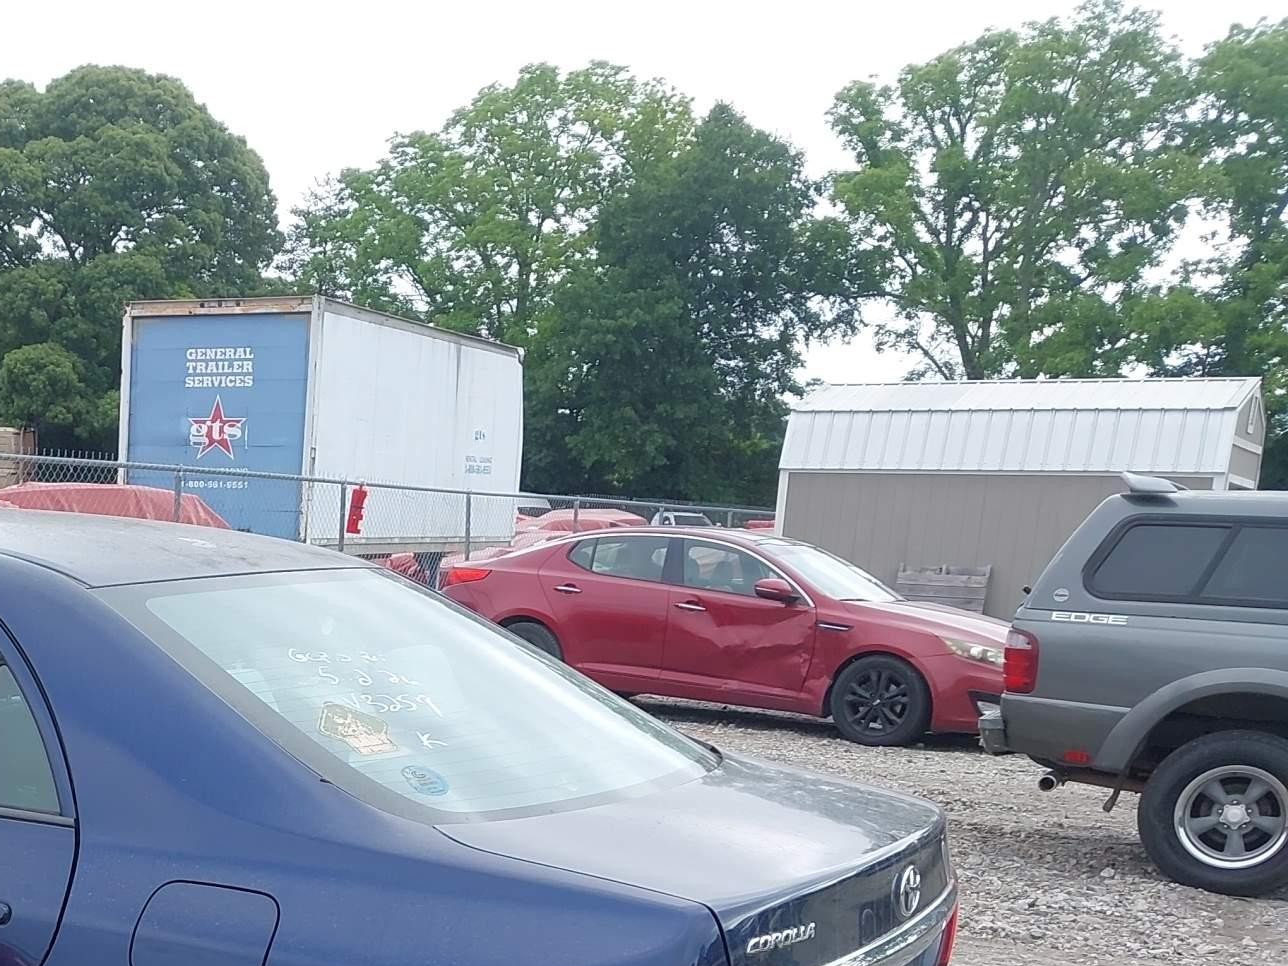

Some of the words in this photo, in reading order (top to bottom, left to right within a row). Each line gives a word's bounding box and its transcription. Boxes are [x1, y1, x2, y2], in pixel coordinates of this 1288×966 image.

[186, 347, 254, 360] GENERAL
[186, 361, 253, 374] TRAILER
[185, 375, 253, 388] SERVICES
[189, 418, 242, 447] gts
[1051, 611, 1128, 625] EDGE
[746, 922, 816, 953] COROLLA
